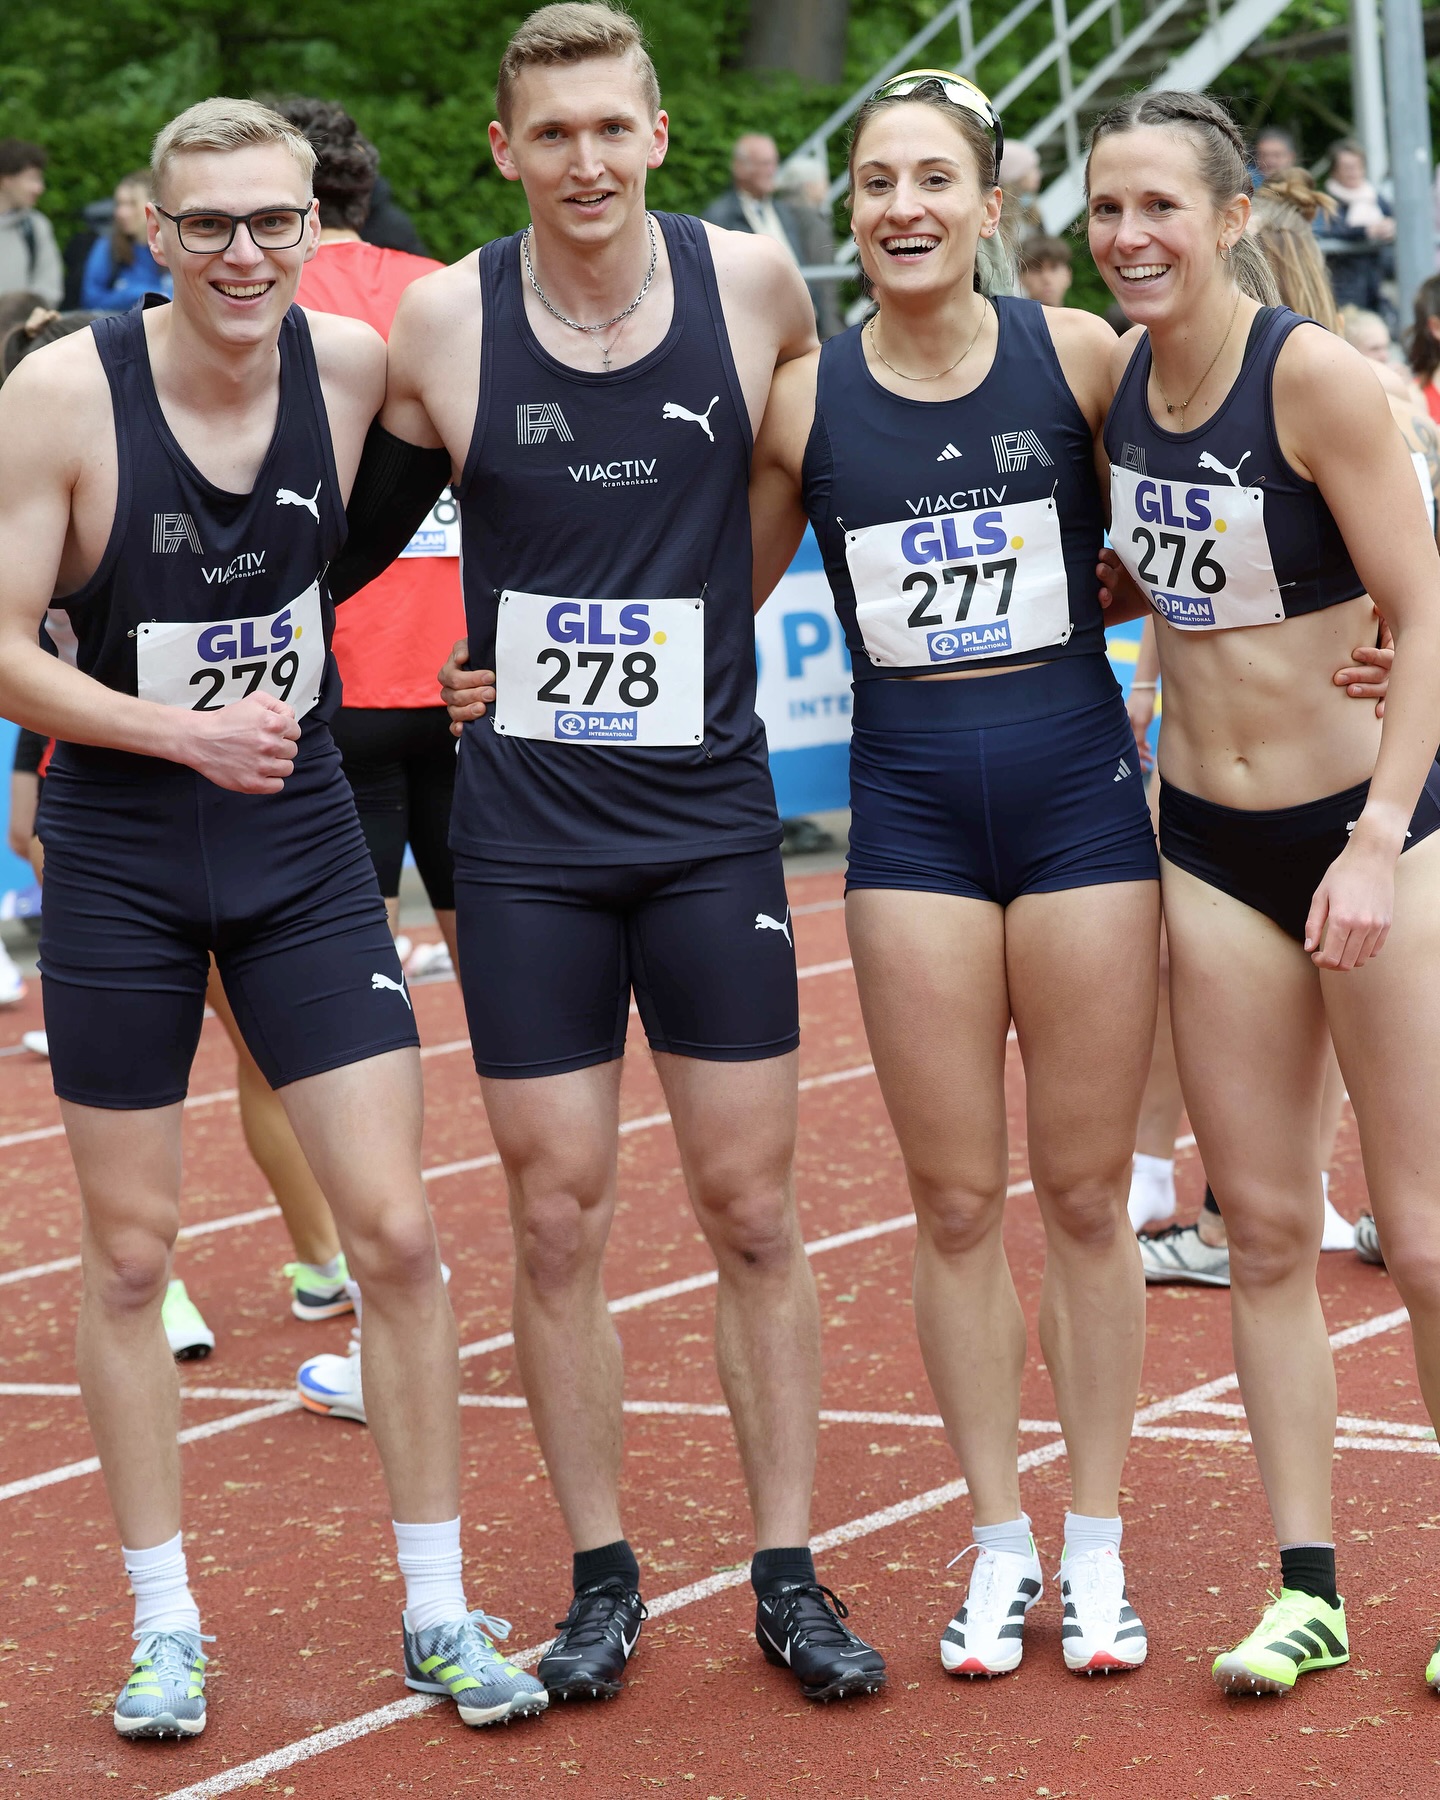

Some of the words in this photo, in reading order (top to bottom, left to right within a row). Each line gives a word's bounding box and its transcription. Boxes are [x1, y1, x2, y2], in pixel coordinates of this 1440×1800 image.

[567, 458, 657, 482] VIACTIV
[602, 477, 658, 488] Krankenkasse
[905, 485, 1008, 515] VIACTIV
[201, 550, 266, 584] VIACTIV
[1132, 526, 1227, 594] 276
[902, 557, 1018, 628] 277
[1171, 600, 1210, 616] PLAN
[1172, 614, 1212, 622] INTERNATIONAL
[962, 627, 1007, 646] PLAN
[963, 641, 1009, 653] INTERNATIONAL
[188, 650, 300, 711] 279
[537, 648, 659, 708] 278
[588, 717, 634, 731] PLAN
